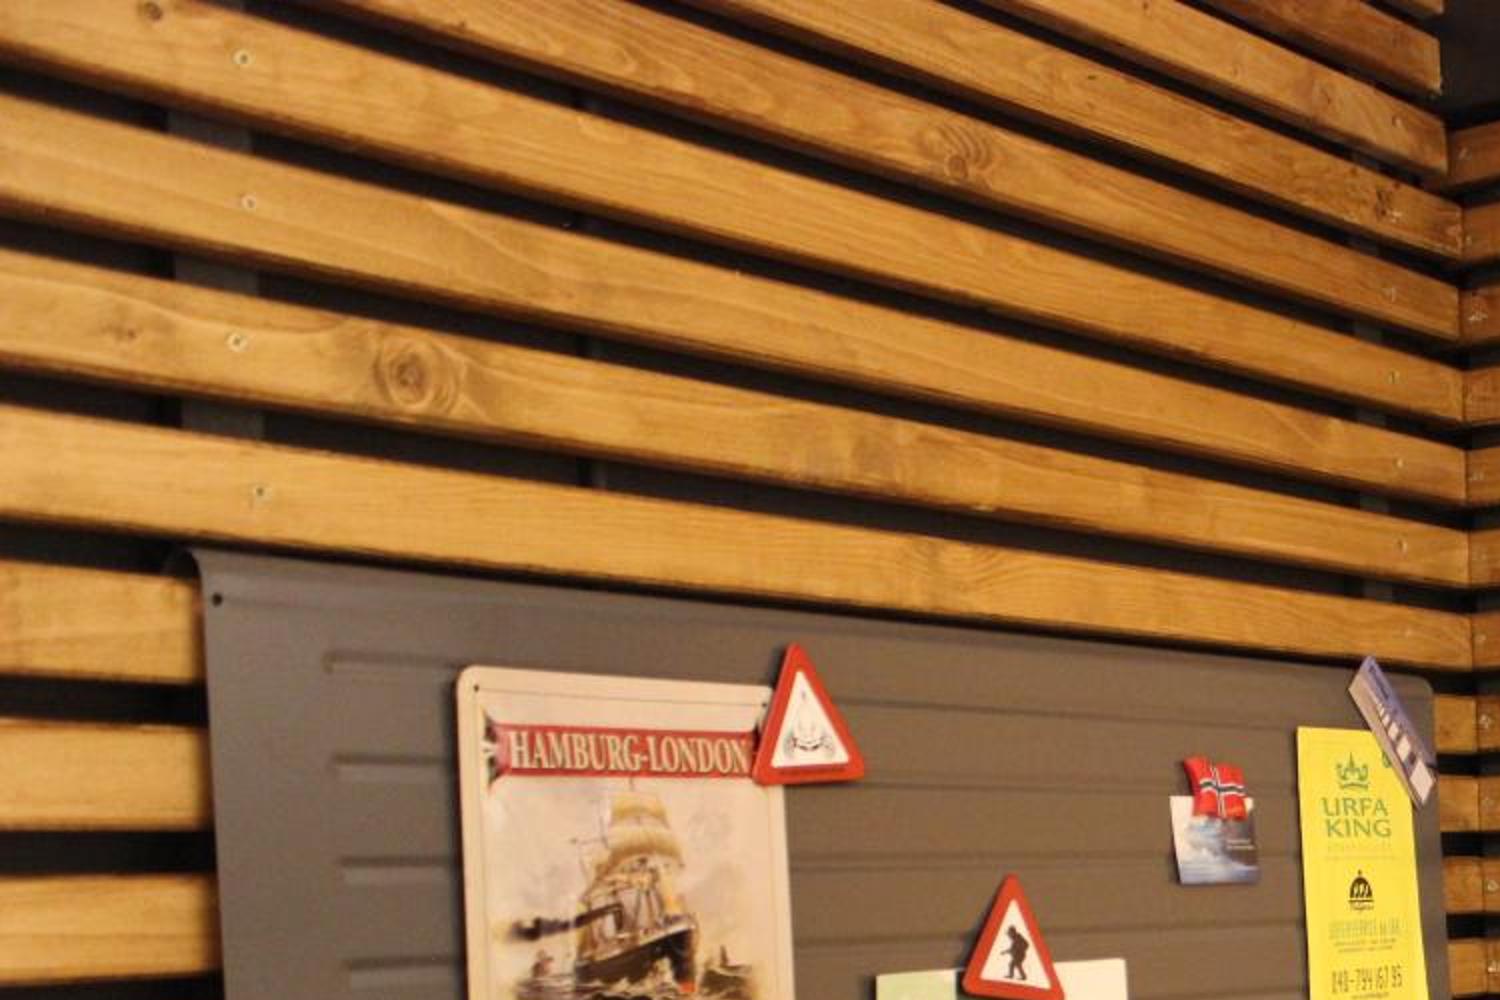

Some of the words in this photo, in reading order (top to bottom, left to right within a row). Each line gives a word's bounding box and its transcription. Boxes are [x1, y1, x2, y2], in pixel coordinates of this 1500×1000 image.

[508, 730, 751, 774] HAMBURG-LONDON
[1321, 797, 1390, 818] URFA
[1325, 819, 1392, 839] KING
